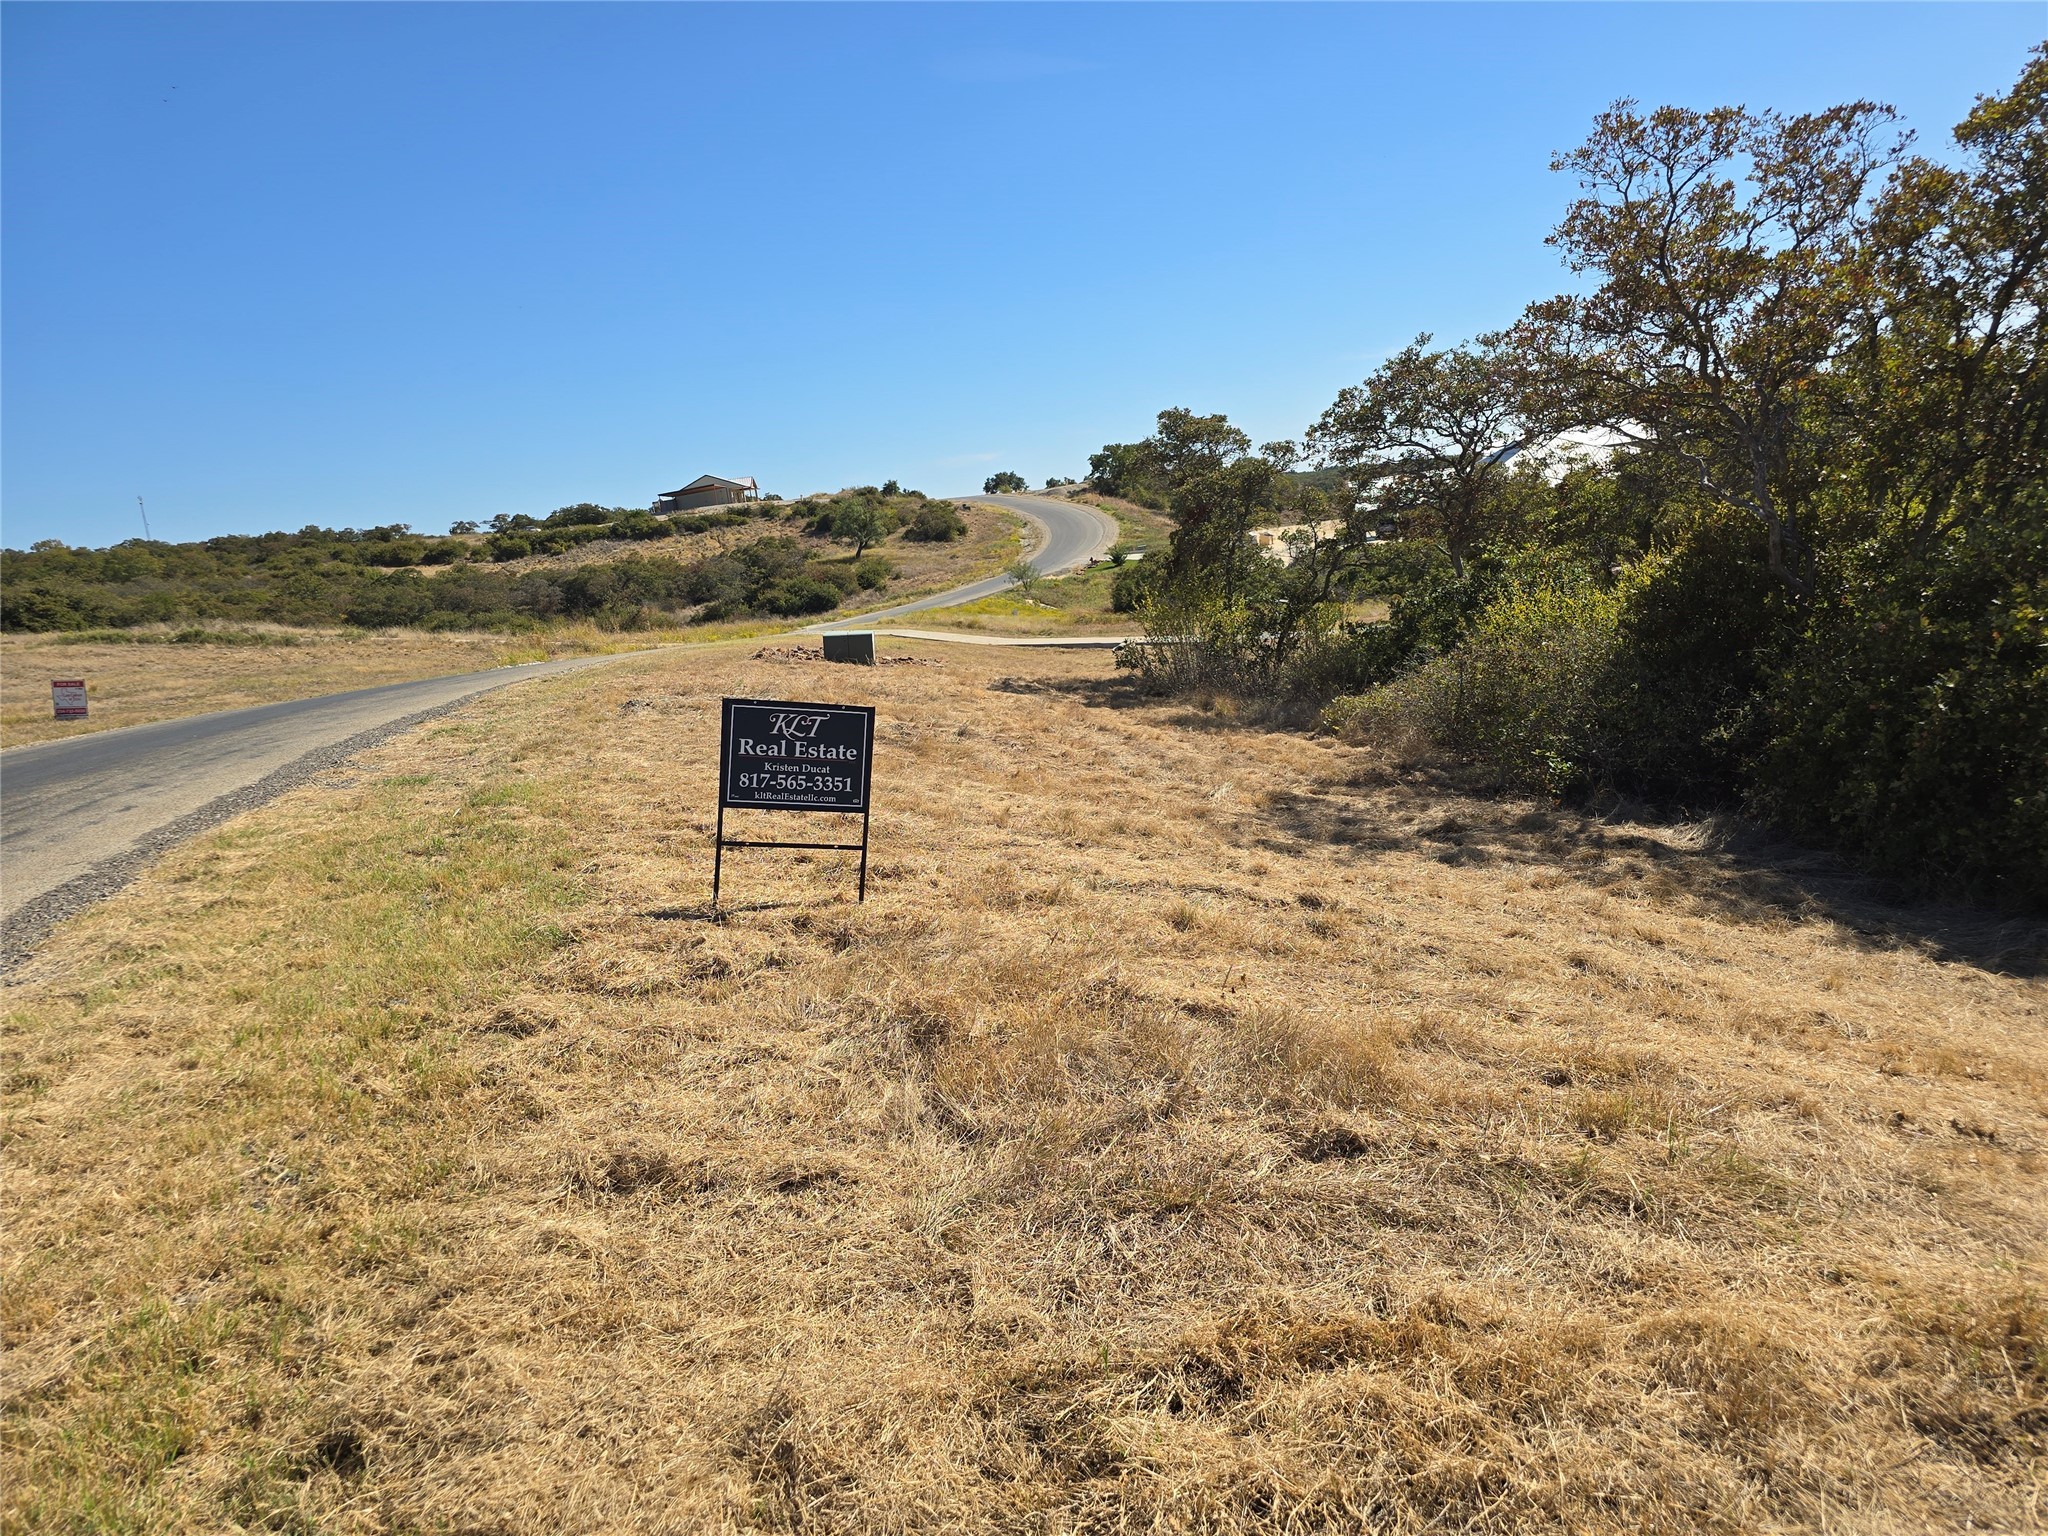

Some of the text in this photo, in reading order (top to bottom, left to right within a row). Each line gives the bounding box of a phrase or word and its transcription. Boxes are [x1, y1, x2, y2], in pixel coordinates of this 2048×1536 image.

[769, 712, 831, 741] KLT
[738, 738, 858, 760] Real Estate
[764, 762, 830, 774] Kristen Ducat
[739, 773, 853, 792] 817-565-3351
[754, 791, 836, 803] kltRealEstatellc.com
